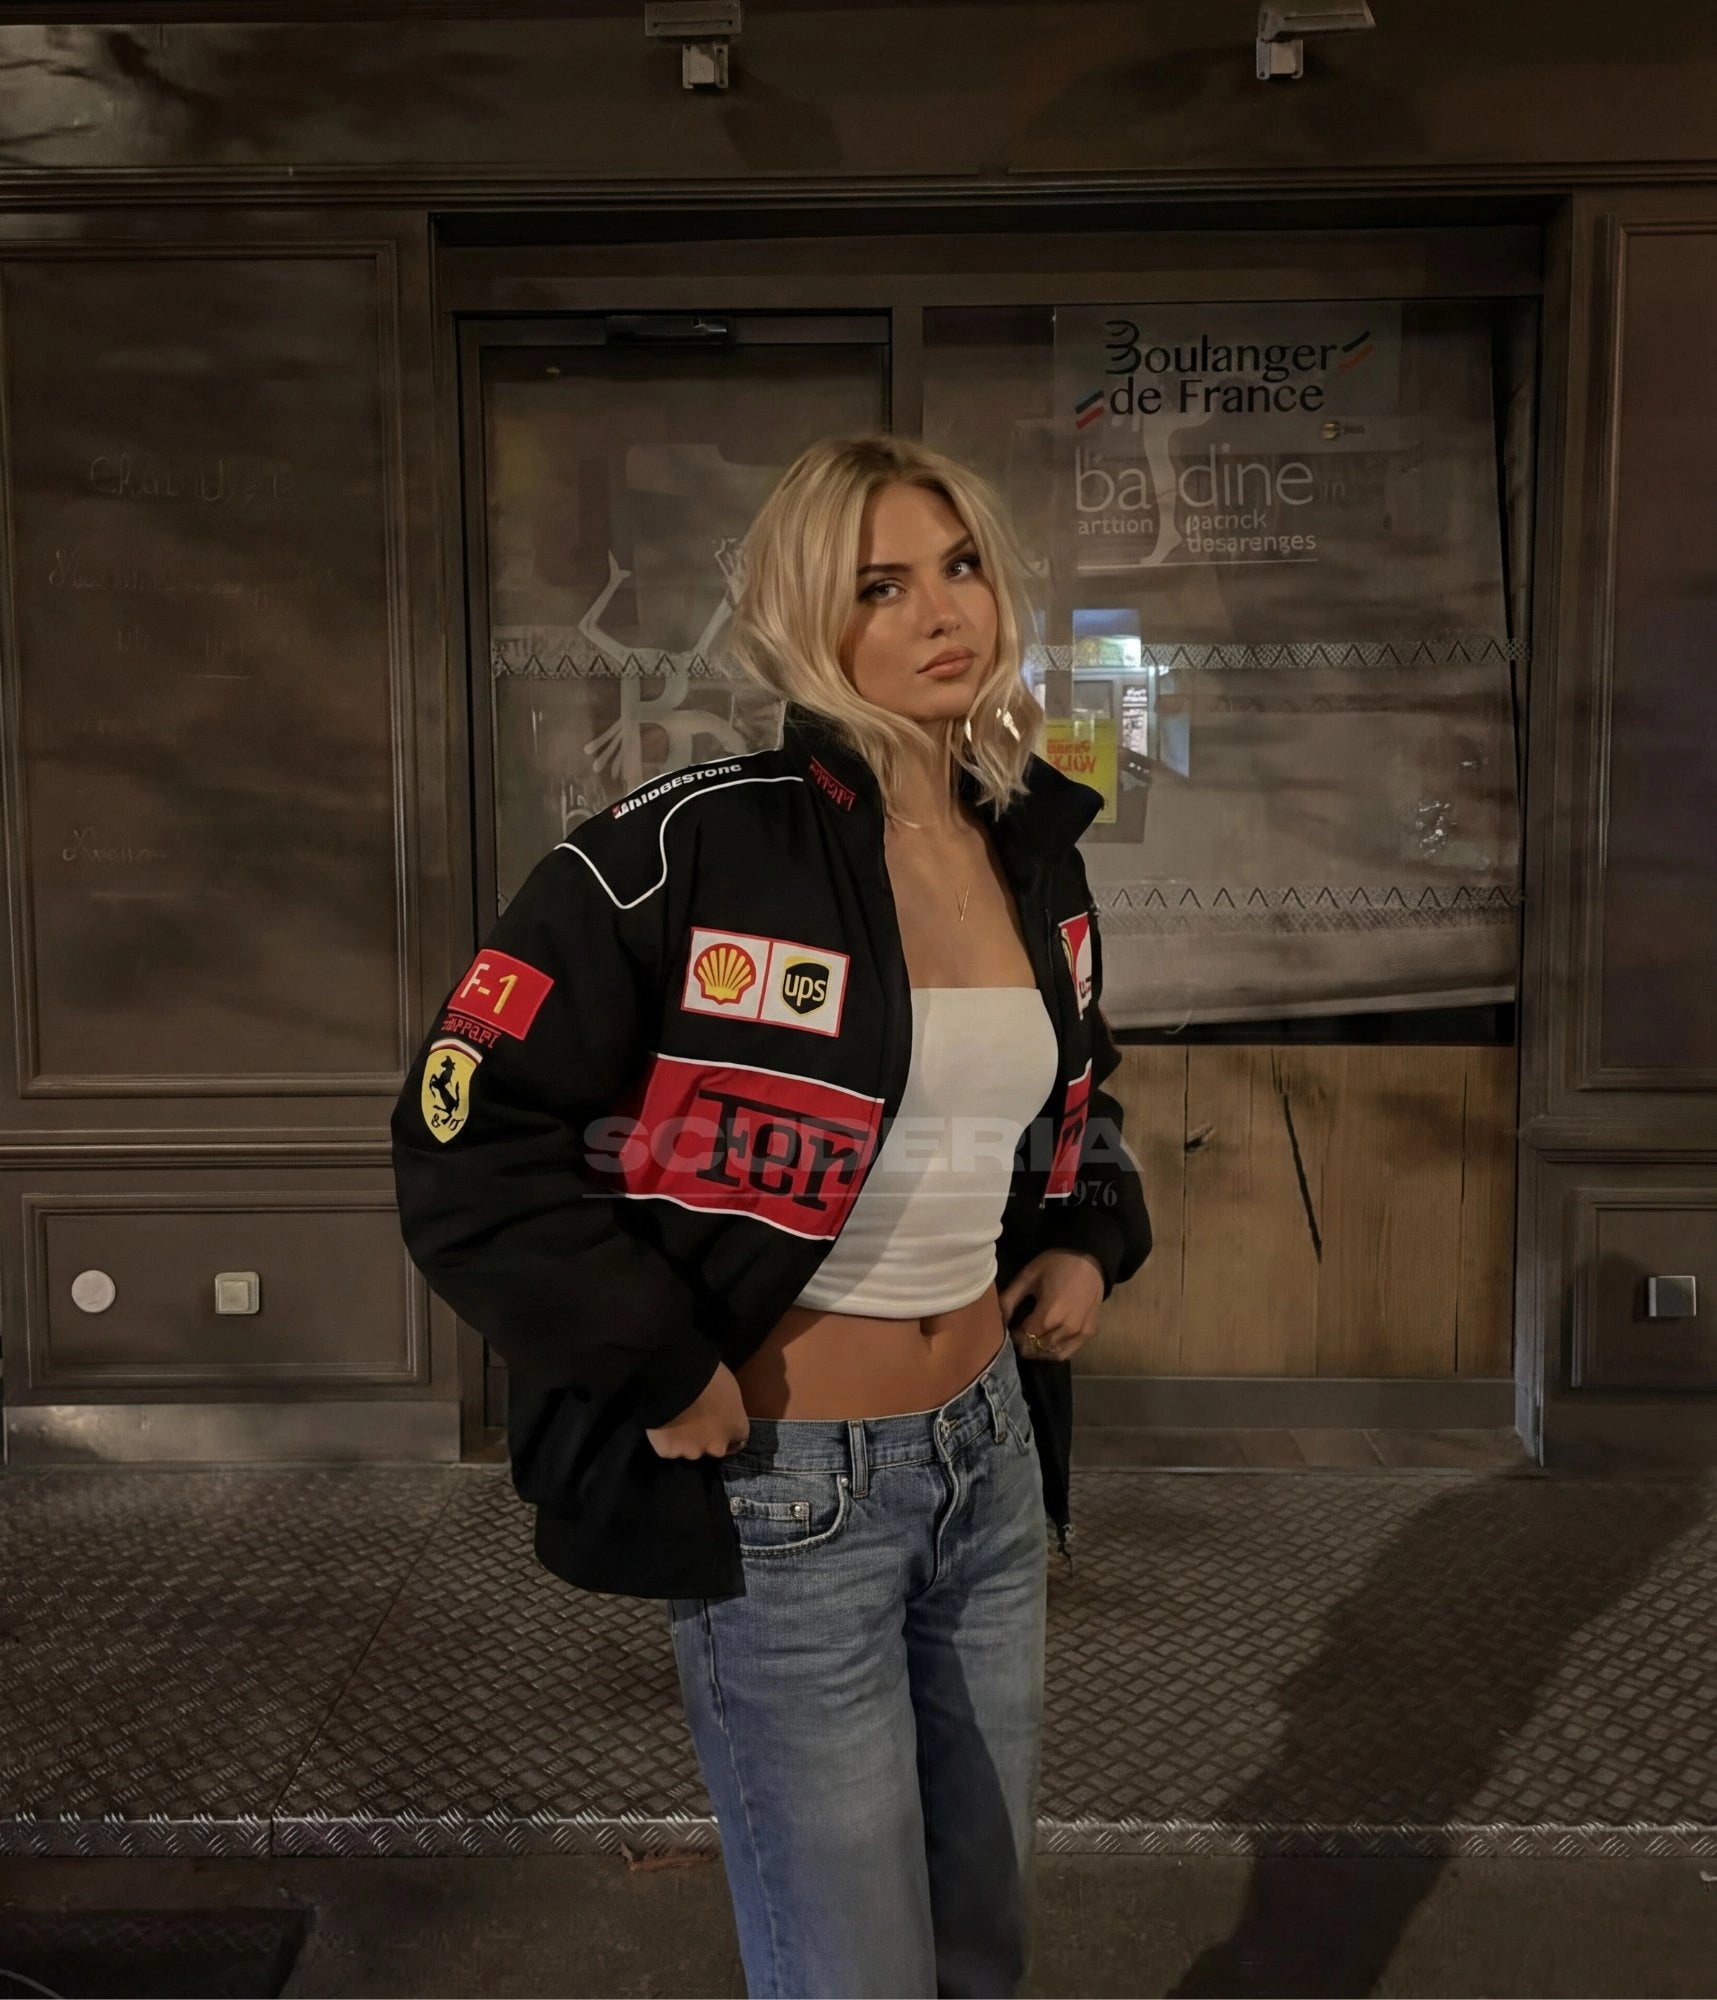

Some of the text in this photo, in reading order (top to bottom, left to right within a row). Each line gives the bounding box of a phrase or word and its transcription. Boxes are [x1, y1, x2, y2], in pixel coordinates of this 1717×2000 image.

[1105, 319, 1338, 383] Boulanger
[1110, 377, 1325, 415] de France
[460, 963, 520, 1015] F-1
[784, 973, 827, 1007] ups
